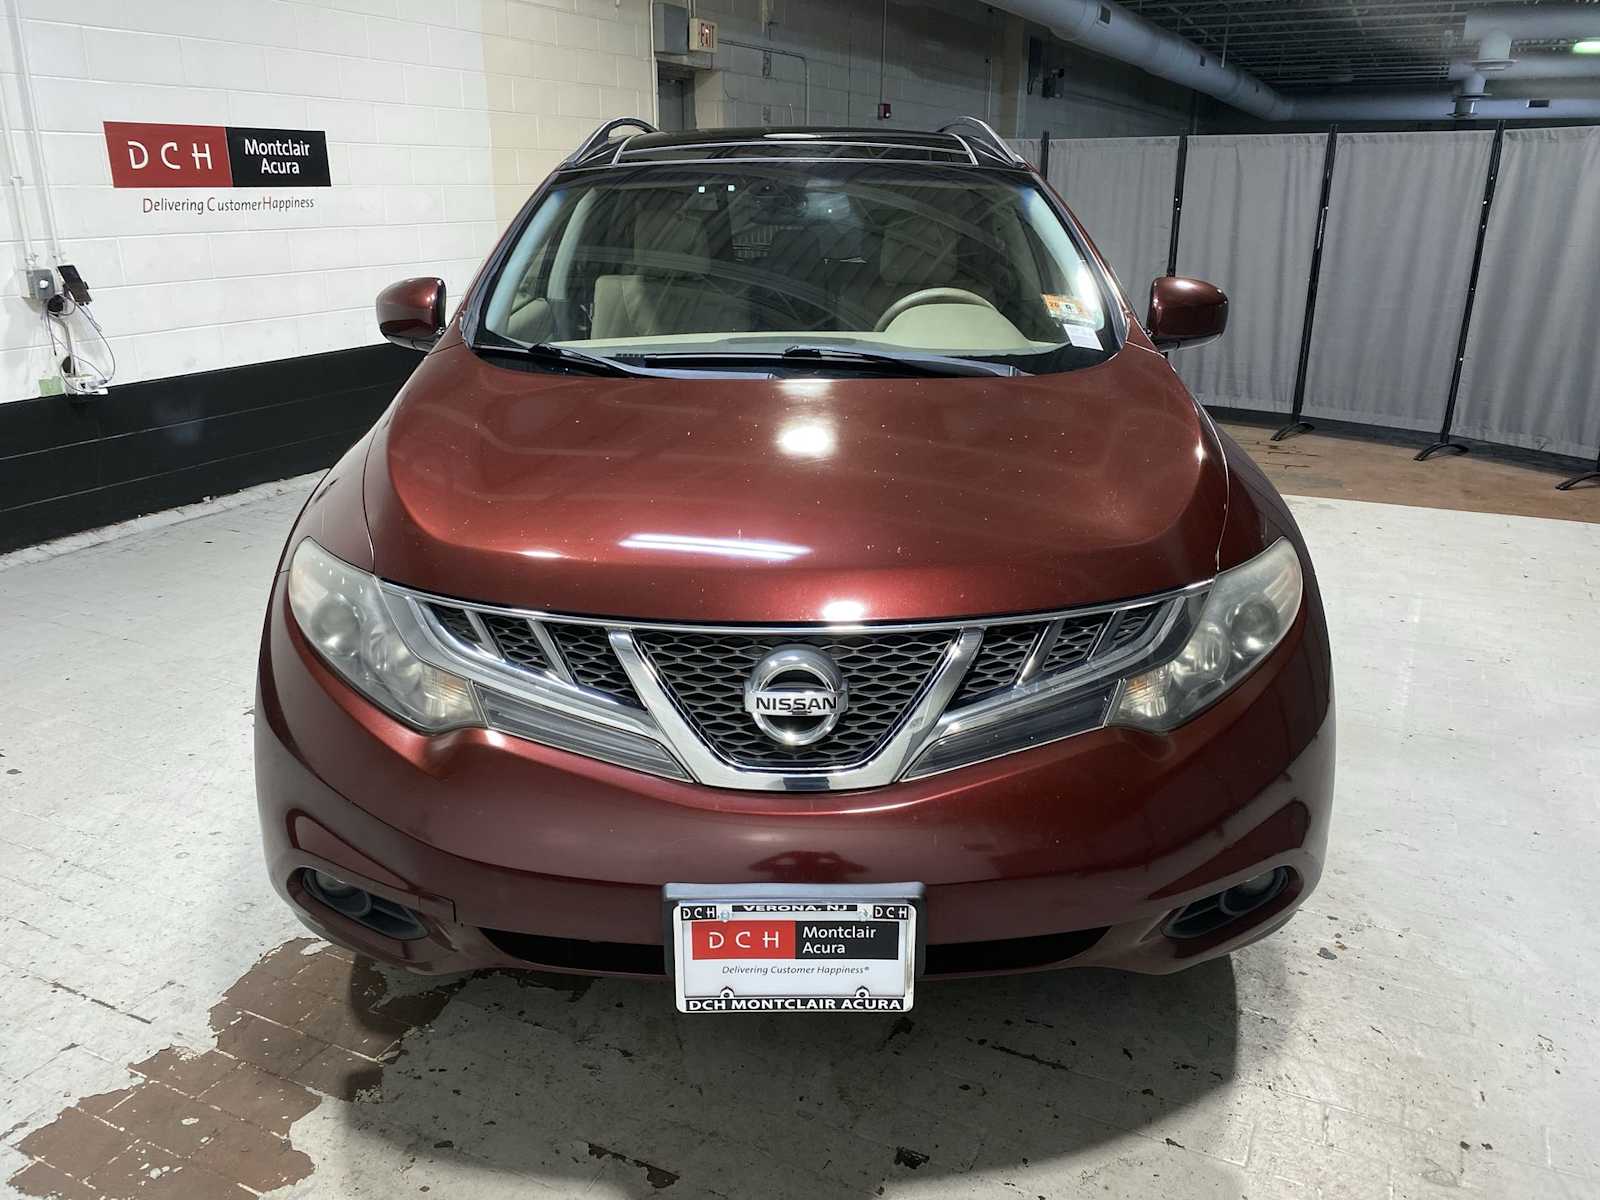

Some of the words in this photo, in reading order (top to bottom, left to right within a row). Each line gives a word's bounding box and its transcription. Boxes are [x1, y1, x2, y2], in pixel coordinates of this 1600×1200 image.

[244, 138, 311, 157] Montclair
[261, 158, 300, 175] Acura
[142, 197, 204, 215] Delivering
[207, 197, 261, 212] Customer
[262, 195, 315, 211] Happiness
[756, 697, 837, 710] NISSAN
[682, 907, 715, 919] DCH
[826, 904, 848, 912] NJ
[875, 906, 908, 918] DCH
[802, 925, 877, 939] Montclair
[708, 930, 780, 949] DCH
[802, 941, 846, 954] Acura
[722, 965, 768, 976] Delivering
[770, 965, 815, 975] Customer
[689, 999, 726, 1011] DCH
[731, 998, 836, 1011] MONTCLAIR
[841, 998, 902, 1011] ACURA
